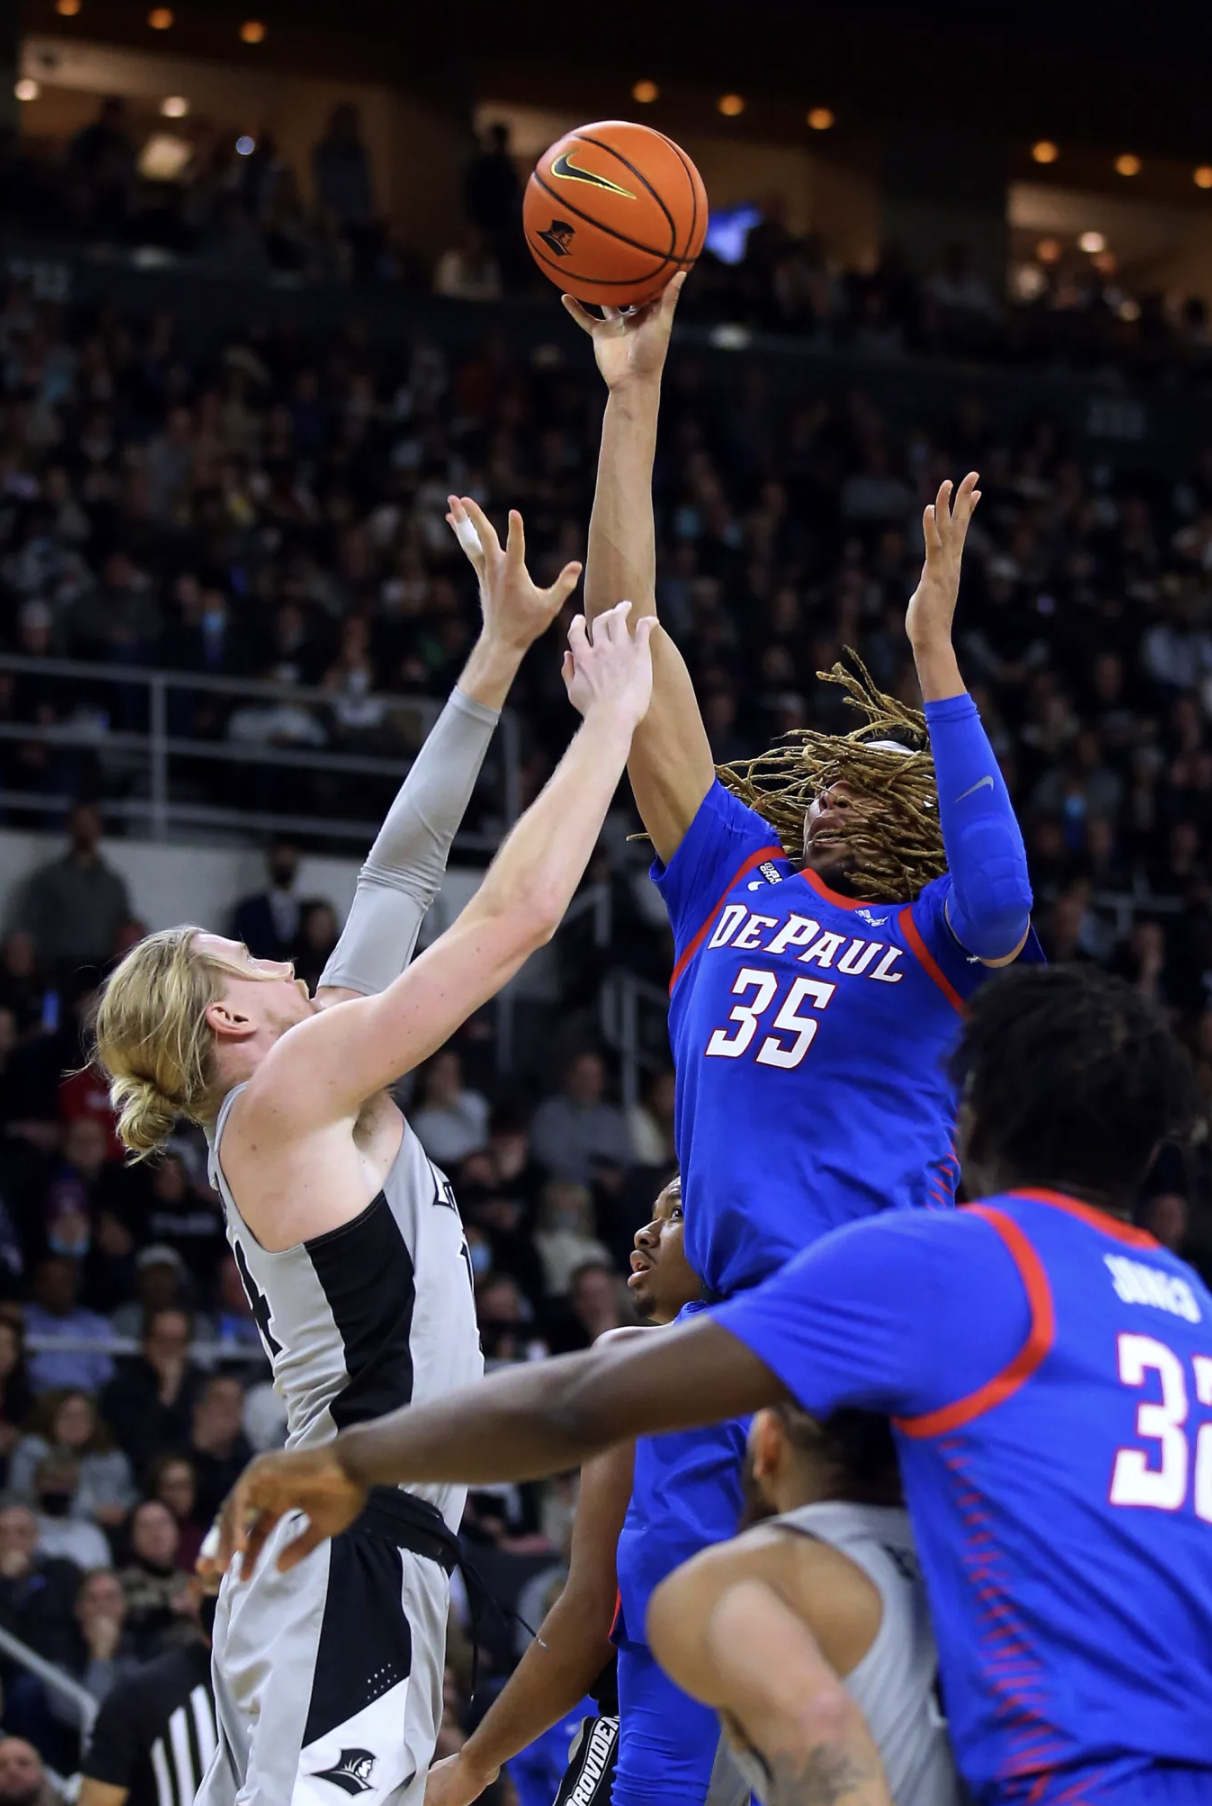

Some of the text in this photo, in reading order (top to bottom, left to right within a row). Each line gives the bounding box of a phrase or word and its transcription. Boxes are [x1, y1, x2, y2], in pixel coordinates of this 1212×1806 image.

[707, 904, 904, 983] DEPAUL
[704, 965, 837, 1070] 35
[1108, 1331, 1212, 1526] 3
